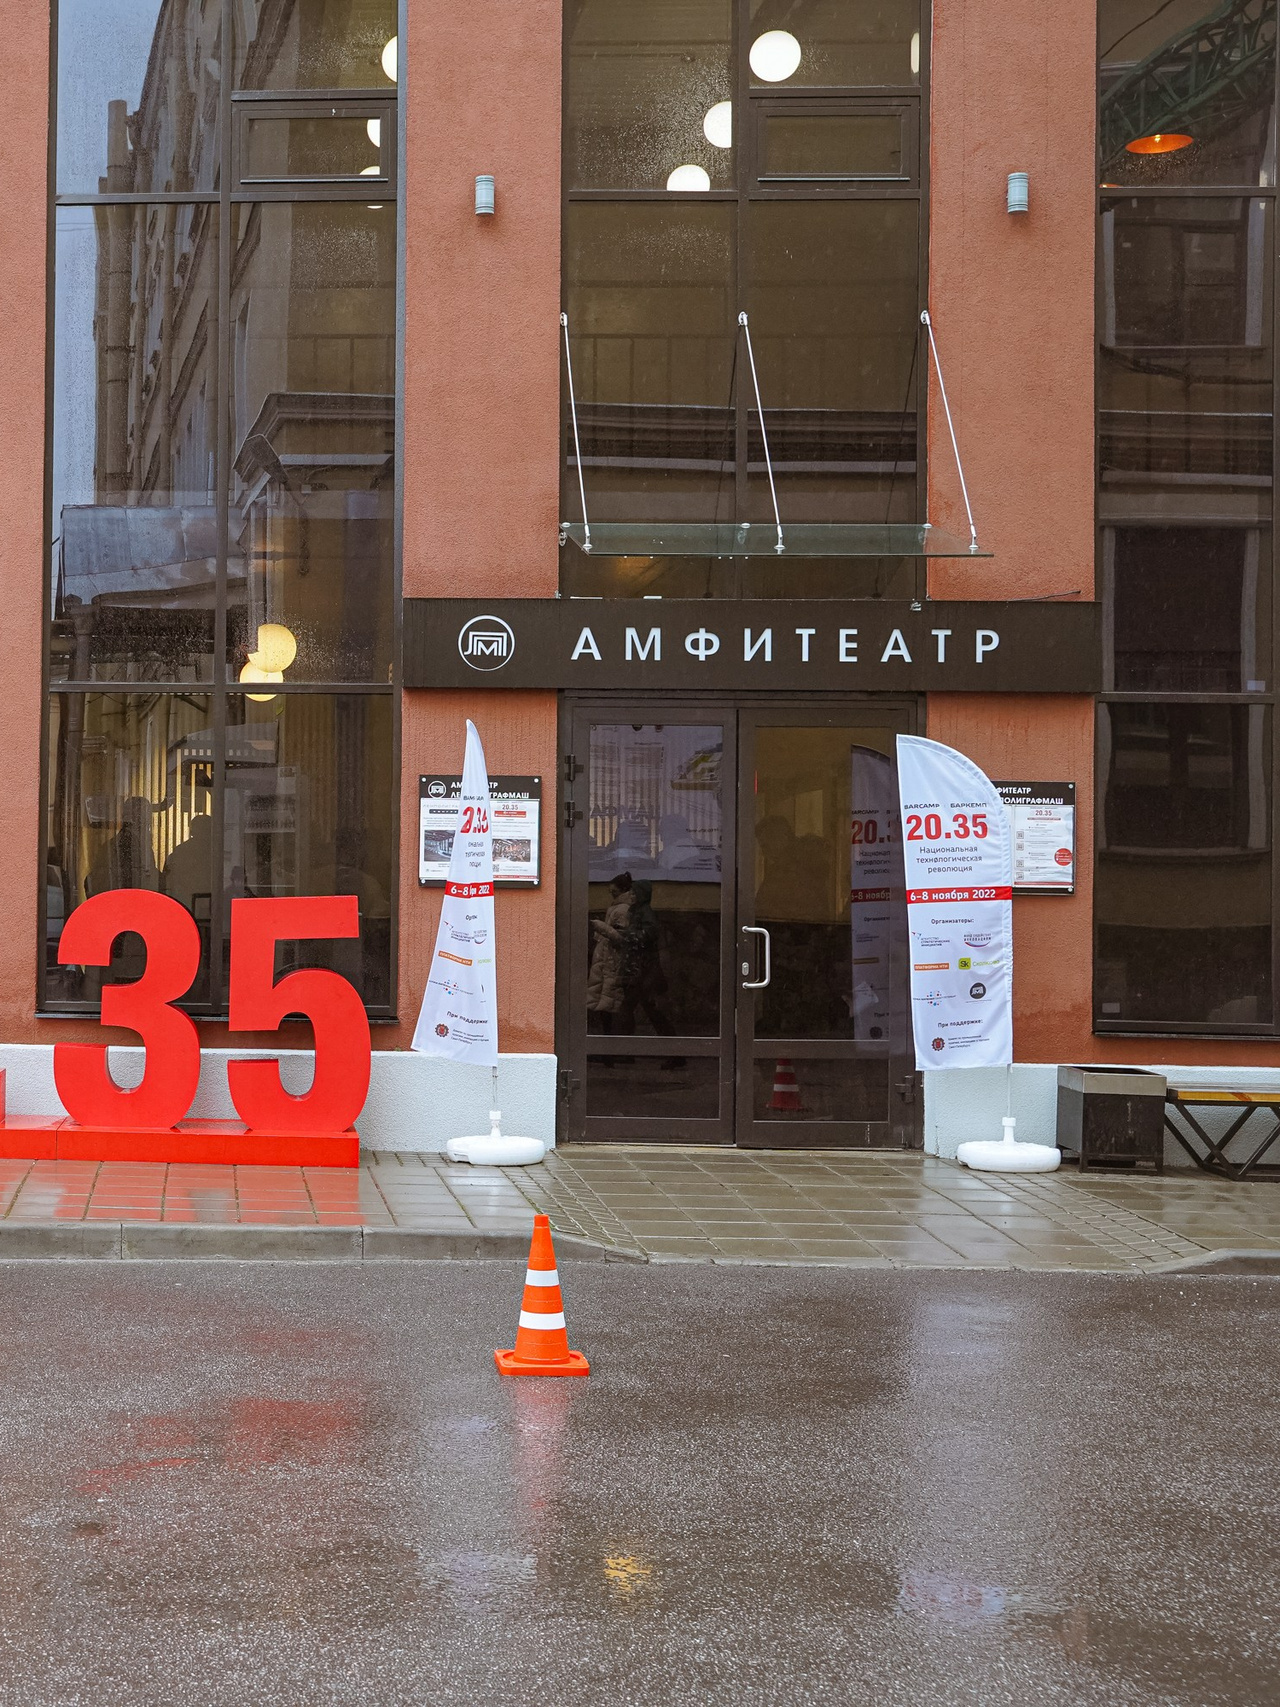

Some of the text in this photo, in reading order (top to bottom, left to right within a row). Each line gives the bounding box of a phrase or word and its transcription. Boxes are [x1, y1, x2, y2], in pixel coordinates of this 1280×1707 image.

[569, 627, 1000, 663] АМФИТЕАТР
[1002, 797, 1064, 805] ОЛИГРАФМАШ
[906, 813, 988, 841] 20.35
[919, 846, 978, 855] Национальная
[927, 865, 973, 875] революция
[932, 887, 969, 902] ноября
[972, 889, 996, 899] 2022
